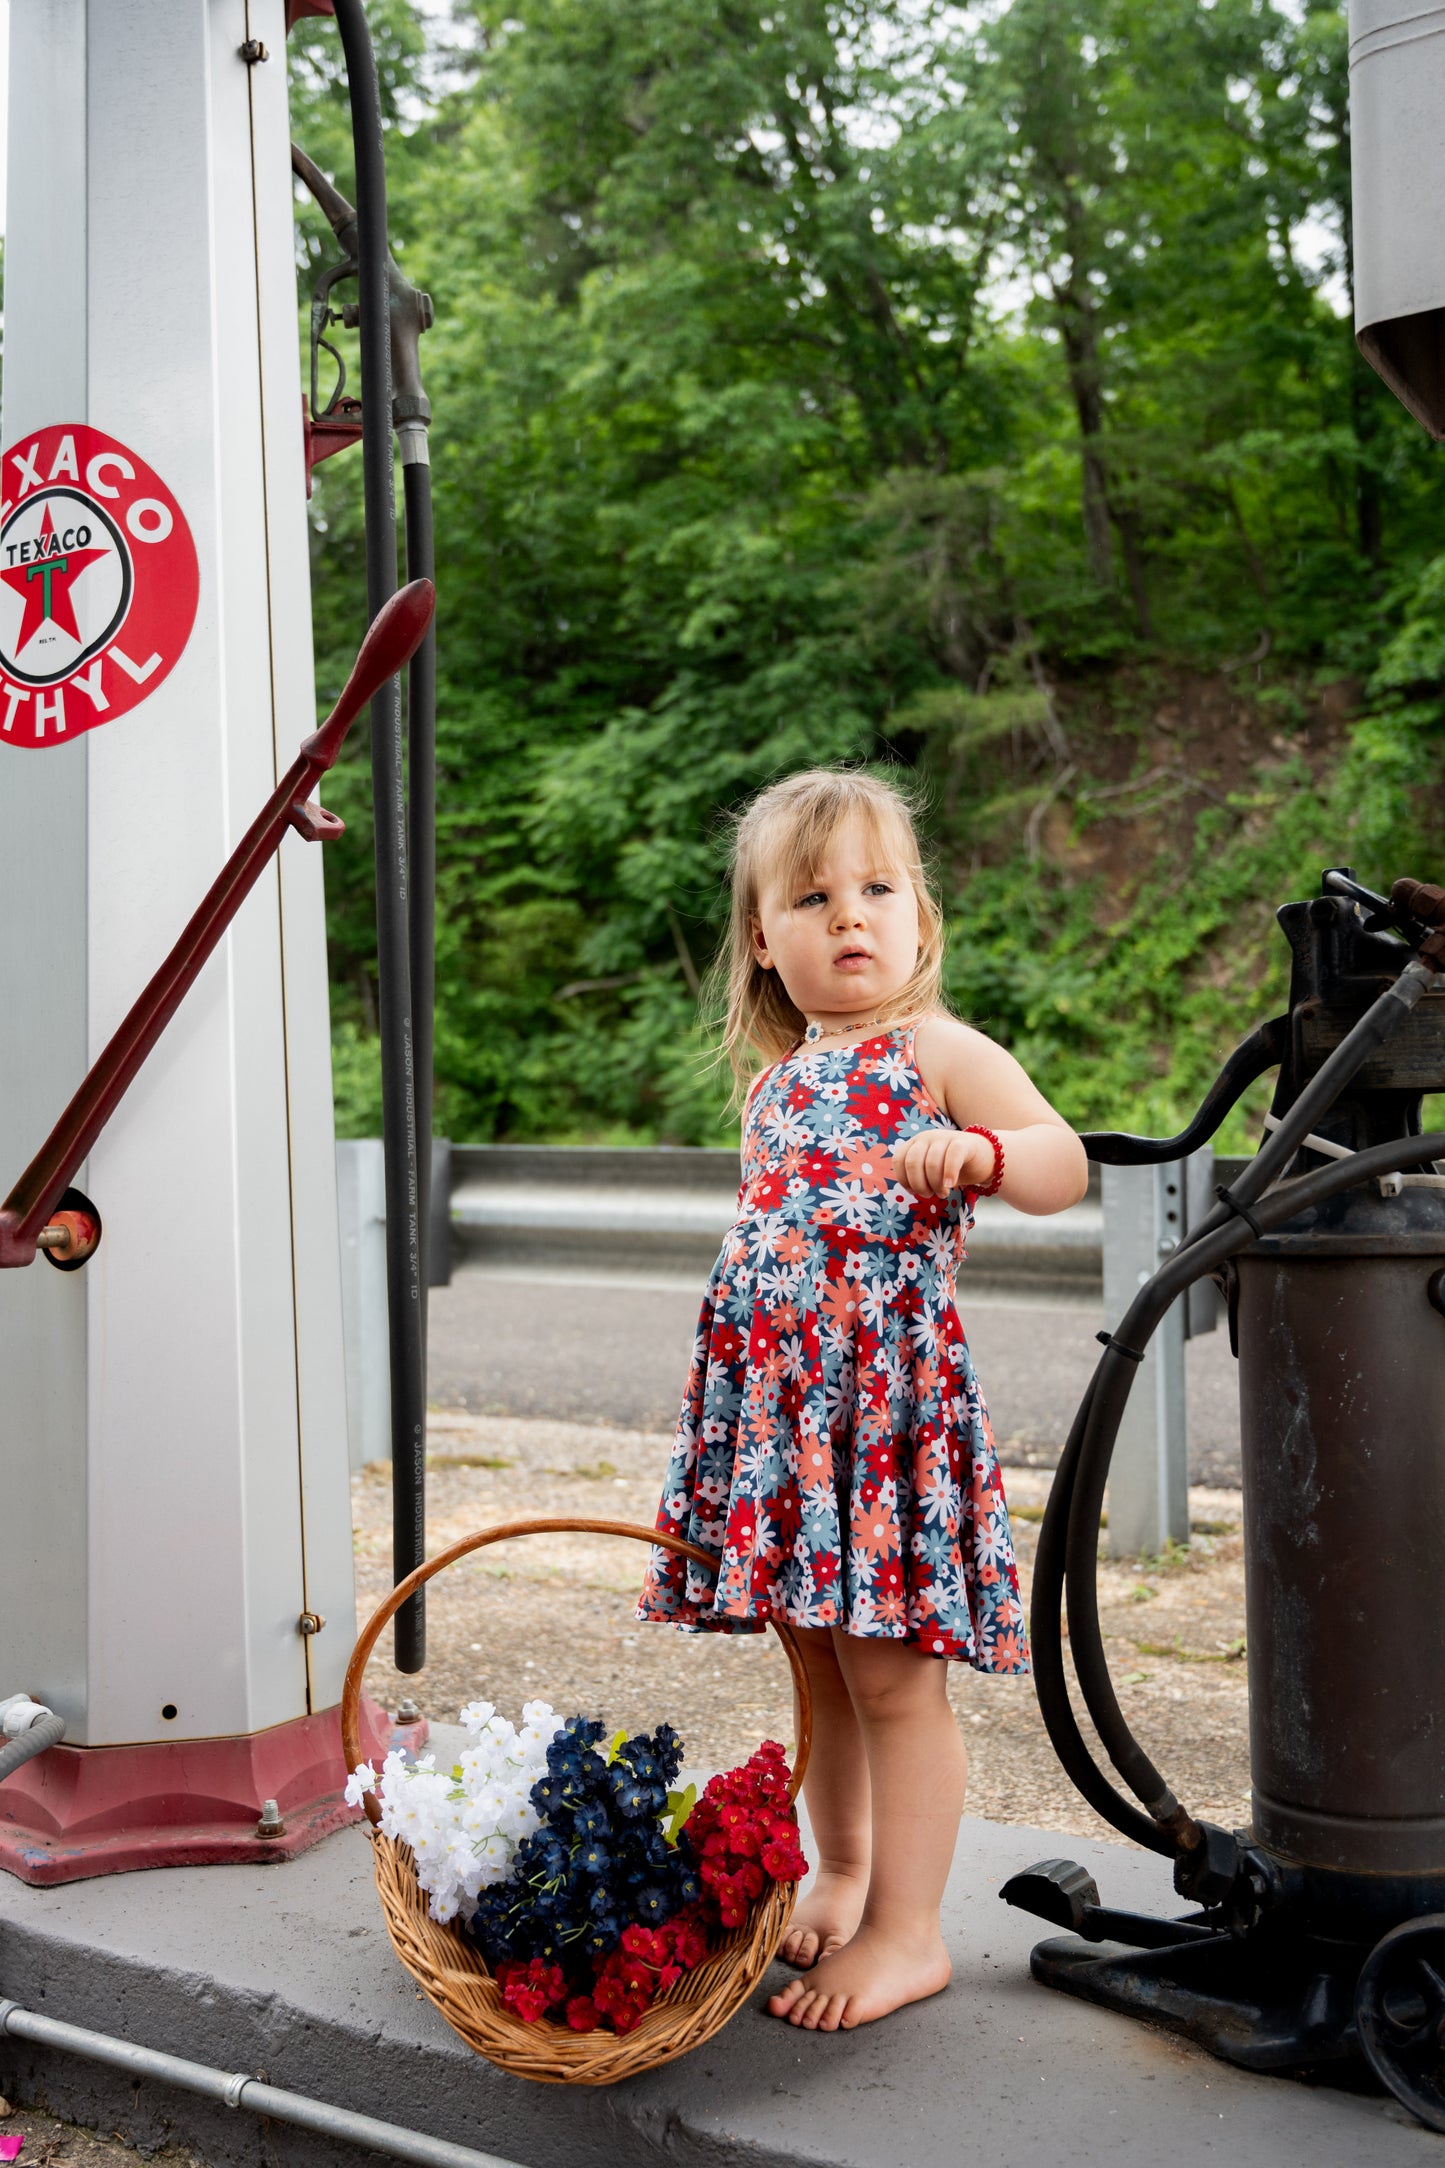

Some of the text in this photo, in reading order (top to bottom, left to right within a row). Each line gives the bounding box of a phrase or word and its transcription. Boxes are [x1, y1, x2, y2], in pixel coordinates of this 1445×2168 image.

[384, 323, 392, 393] INDUSTRIAL
[0, 435, 174, 543] XACO
[6, 525, 92, 566] TEXACO
[26, 557, 68, 620] T
[0, 645, 163, 738] THYL
[400, 886, 406, 900] ID
[404, 1033, 413, 1076] JASON
[406, 1083, 415, 1158] INDUSTRIAL
[408, 1170, 416, 1206] FARM
[409, 1212, 417, 1246] TANK
[411, 1285, 417, 1299] ID
[414, 1441, 423, 1485] JASON
[414, 1492, 423, 1566] INDUSTRIAL
